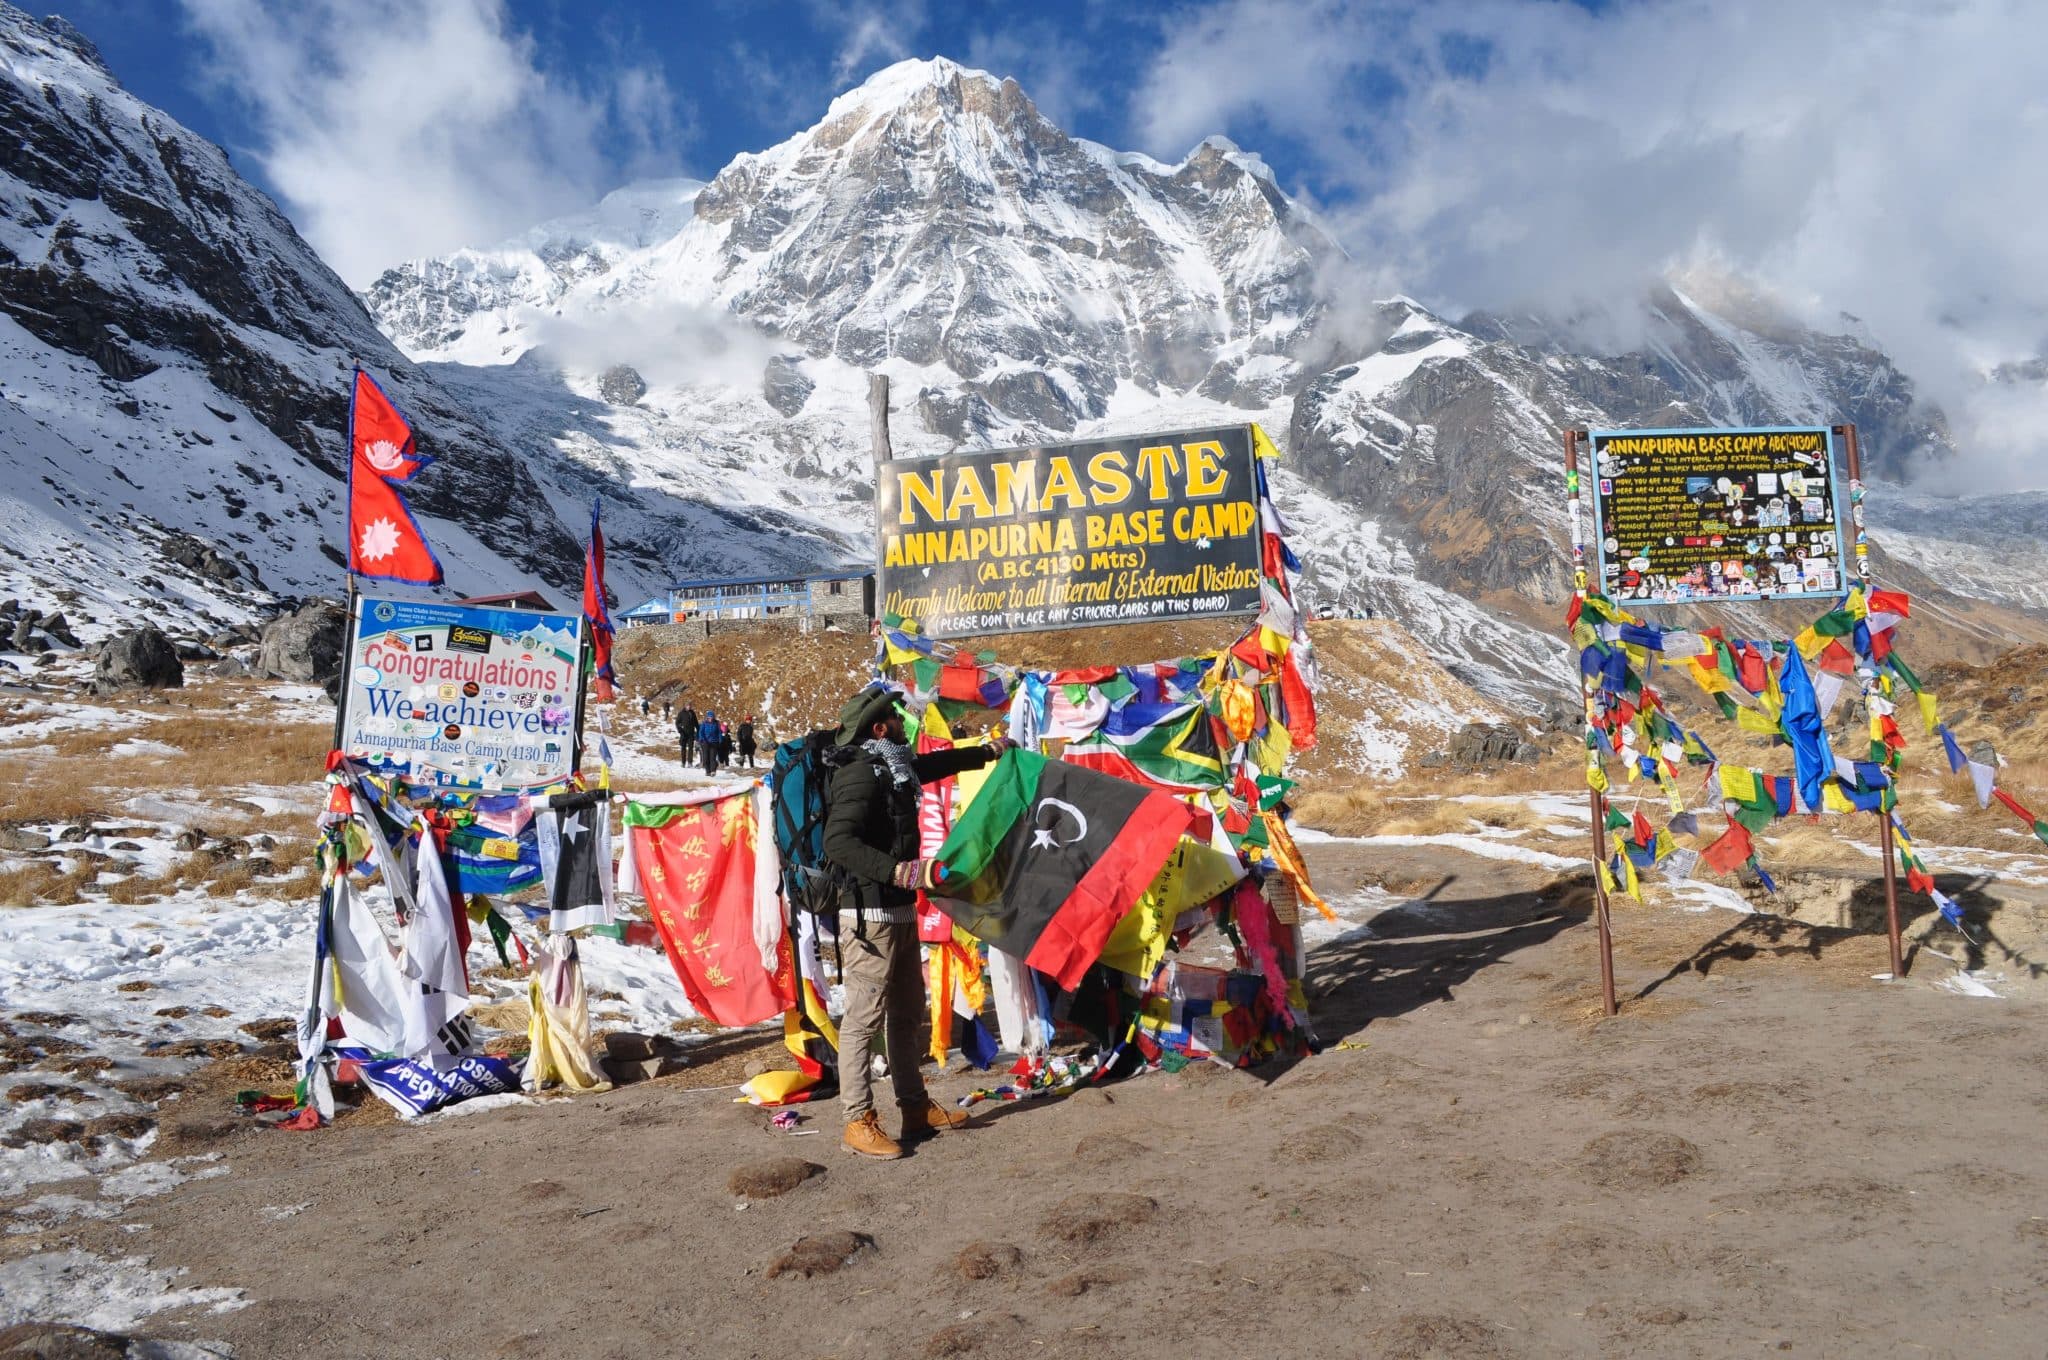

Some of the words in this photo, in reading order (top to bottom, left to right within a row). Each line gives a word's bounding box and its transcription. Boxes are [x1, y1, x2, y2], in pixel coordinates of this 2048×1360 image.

[1608, 437, 1698, 456] ANNAPURNA
[1698, 436, 1733, 454] BASE
[1734, 435, 1767, 454] CAMP
[896, 439, 1229, 526] NAMASTE
[884, 518, 1078, 568] ANNAPURNA
[1086, 509, 1165, 549] BASE
[1172, 501, 1257, 543] CAMP
[1090, 547, 1147, 572] Mtrs)
[885, 587, 942, 622] Warmly
[944, 583, 1006, 614] Welcome
[1008, 581, 1025, 609] to
[1025, 579, 1047, 608] all
[1049, 572, 1114, 606] Internal
[1202, 561, 1260, 594] Visitors
[981, 612, 1010, 628] DON'T
[1014, 609, 1046, 626] PLACE
[1048, 607, 1070, 624] ANY
[1151, 600, 1165, 614] ON
[1166, 598, 1190, 612] THIS
[1192, 593, 1230, 612] BOARD)
[365, 643, 557, 691] Congratulations
[366, 687, 413, 720] We
[353, 729, 426, 752] Annapurna
[431, 737, 462, 754] Base
[465, 740, 503, 762] Camp
[505, 744, 540, 764] (4130
[922, 785, 947, 861] TWIN
